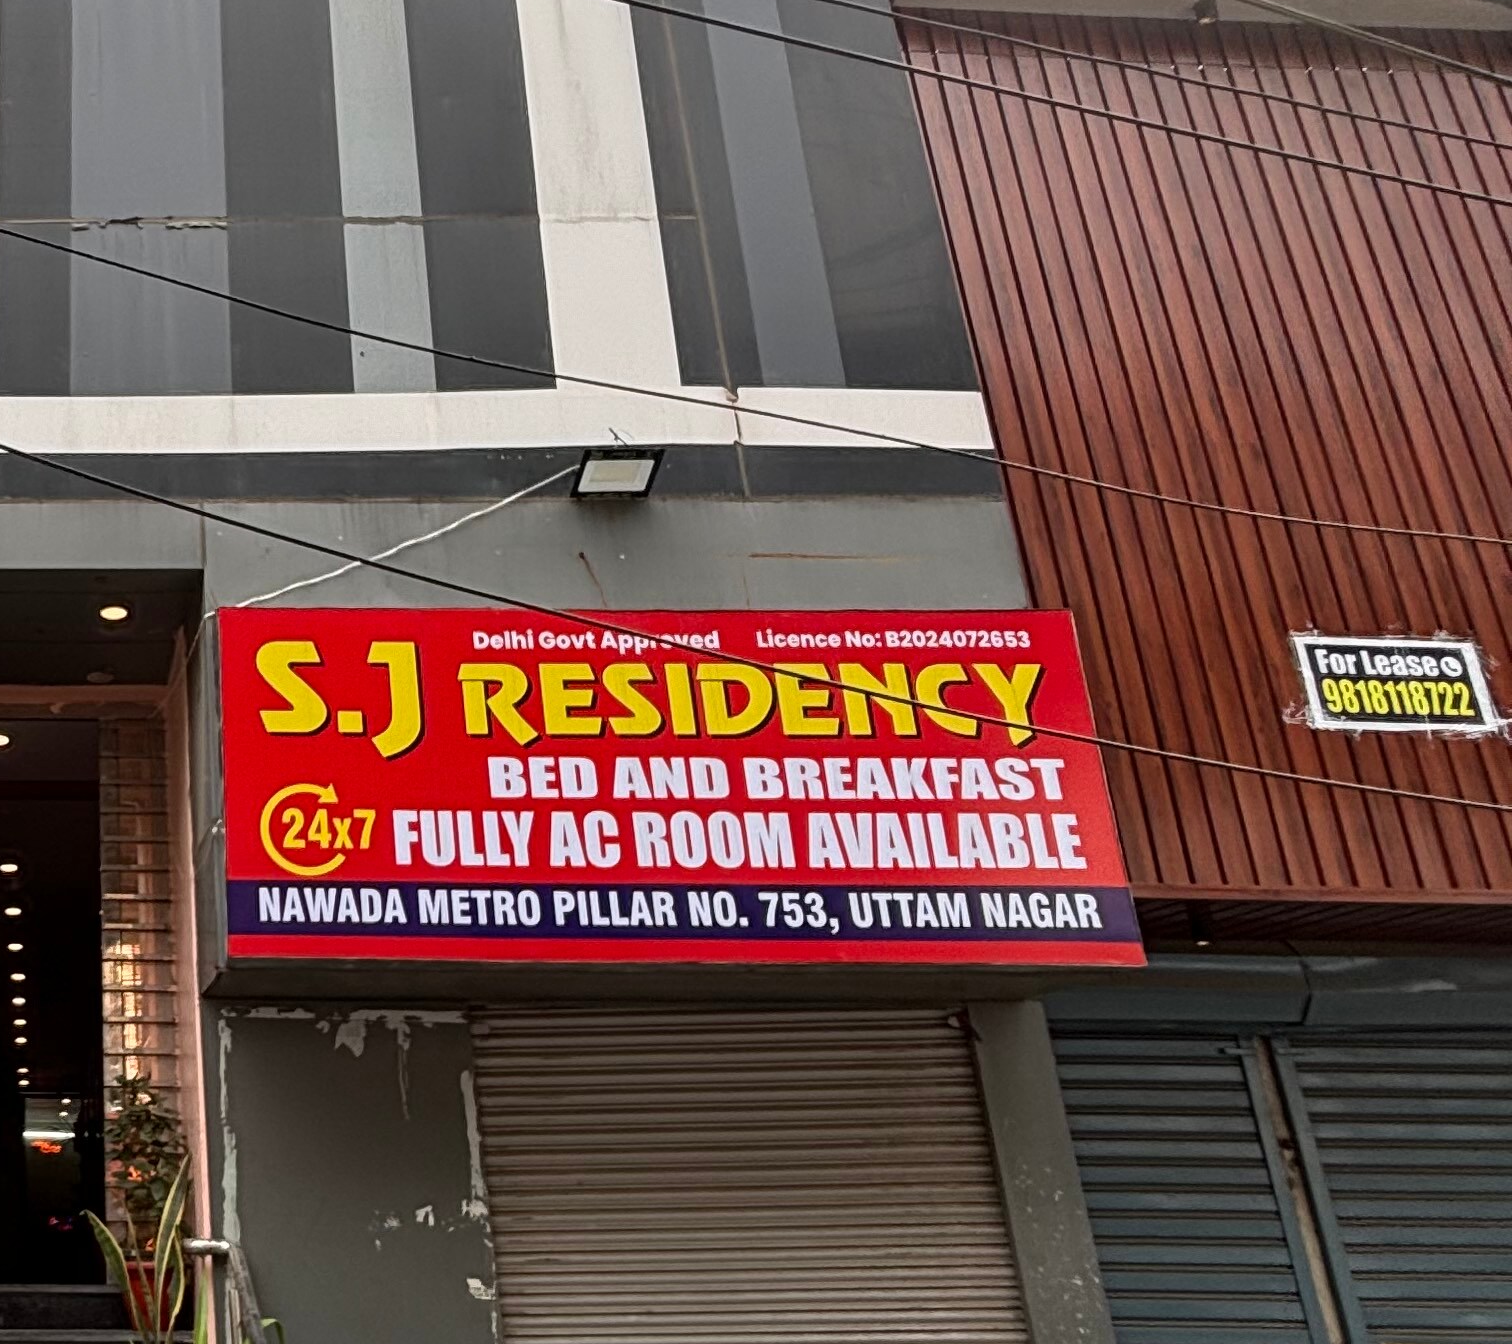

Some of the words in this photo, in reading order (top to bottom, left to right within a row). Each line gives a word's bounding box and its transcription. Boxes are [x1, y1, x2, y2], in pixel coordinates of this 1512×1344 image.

[472, 629, 535, 650] Delhi
[538, 631, 597, 650] Govt
[600, 630, 721, 655] Approved
[756, 630, 841, 649] Licence
[844, 630, 883, 649] No:
[885, 630, 1031, 649] B2024072653
[1314, 648, 1357, 675] For
[1359, 650, 1439, 677] Lease
[255, 641, 422, 757] S.J
[457, 662, 1041, 747] RESIDENCY
[1321, 678, 1476, 716] 9818118722
[488, 756, 598, 799] BED
[612, 757, 730, 800] AND
[743, 757, 1065, 800] BREAKFAST
[281, 808, 377, 849] 24x7
[392, 809, 535, 868] FULLY
[549, 811, 622, 868] AC
[632, 811, 797, 868] ROOM
[808, 812, 1088, 869] AVAILABLE
[258, 887, 407, 924] NAWADA
[418, 889, 541, 926] METRO
[553, 890, 678, 927] PILLAR
[688, 891, 749, 928] NO.
[758, 892, 839, 934] 753,
[848, 892, 971, 929] UTTAM
[982, 893, 1103, 929] NAGAR
